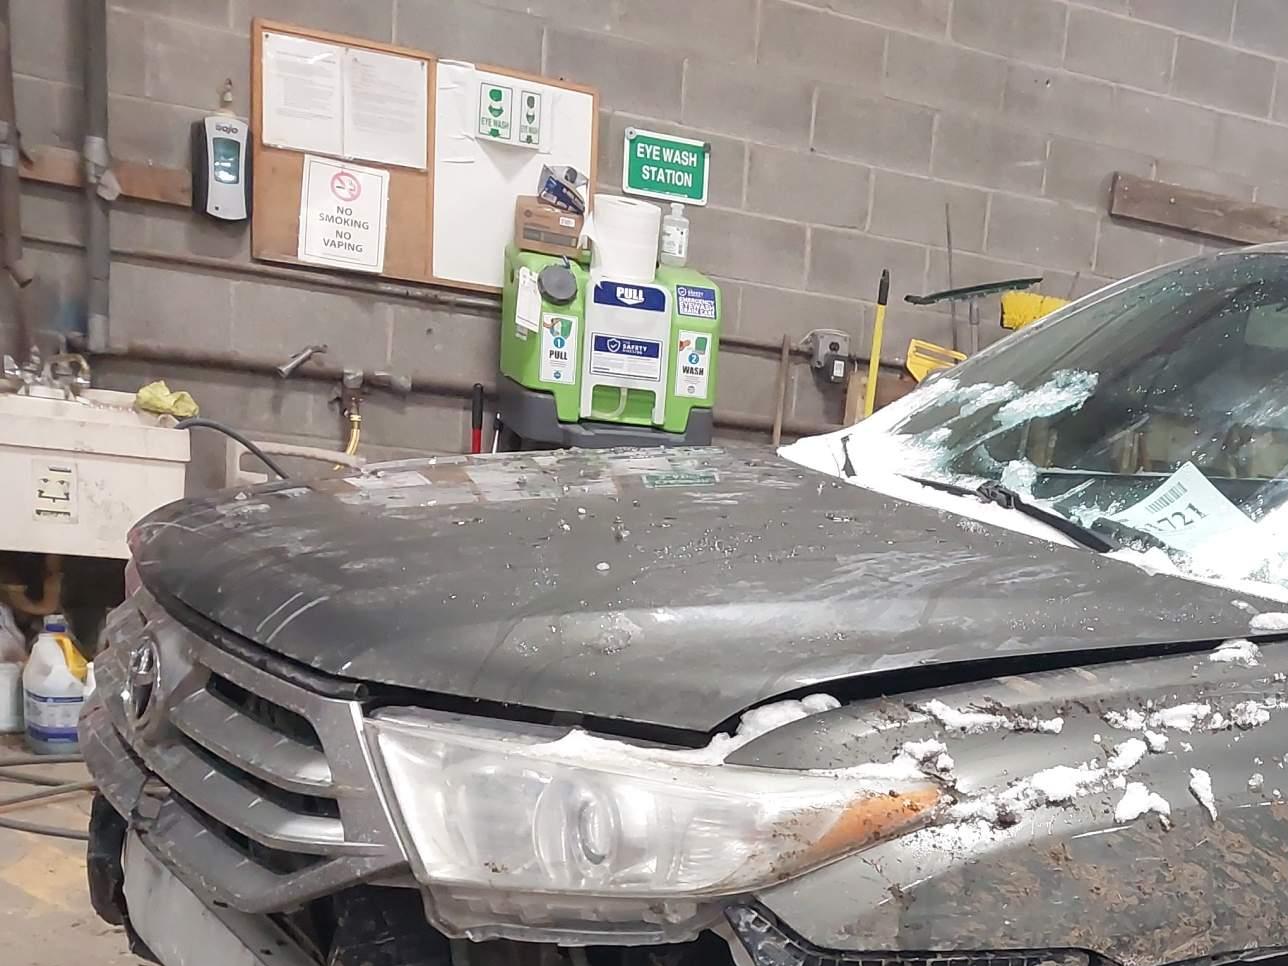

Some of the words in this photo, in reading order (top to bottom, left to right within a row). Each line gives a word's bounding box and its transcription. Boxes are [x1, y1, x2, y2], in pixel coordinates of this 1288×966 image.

[636, 142, 661, 161] EYE
[662, 147, 698, 168] WASH
[641, 164, 693, 188] STATION
[336, 205, 353, 216] NO
[319, 212, 370, 231] SMOKING
[335, 229, 352, 241] NO
[322, 237, 364, 253] VAPING
[615, 286, 645, 301] PULL
[680, 301, 716, 312] EYEWASH
[549, 349, 568, 360] PULL
[690, 354, 697, 364] 2
[682, 365, 705, 376] WASH
